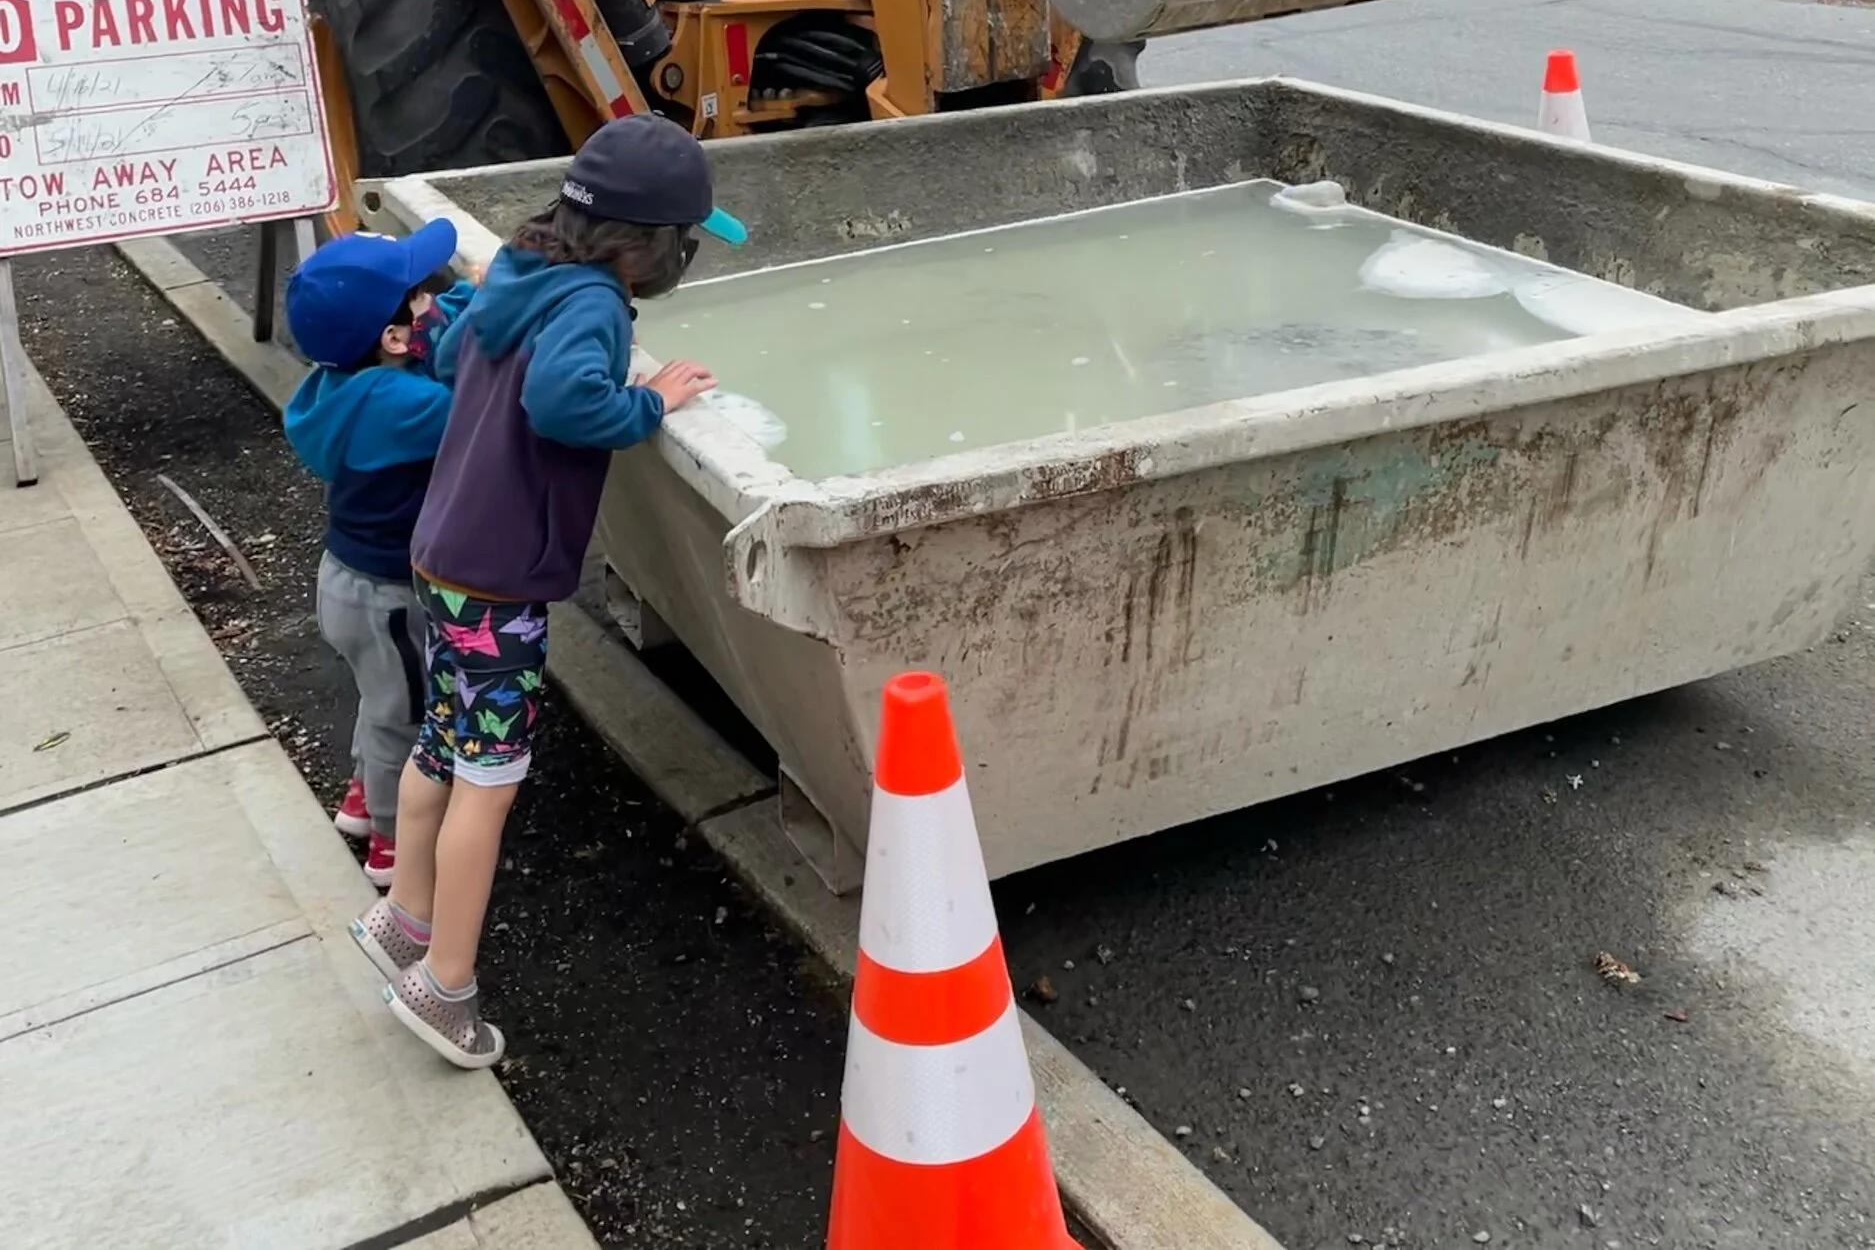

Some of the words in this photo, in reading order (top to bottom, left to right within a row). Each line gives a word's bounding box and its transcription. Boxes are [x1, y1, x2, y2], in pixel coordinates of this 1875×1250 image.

[0, 171, 64, 202] TOW
[93, 158, 177, 191] AWAY
[206, 146, 288, 177] AREA
[14, 215, 101, 239] NORTHWEST
[109, 205, 182, 227] CONCRETE
[190, 199, 226, 216] (206)
[229, 191, 290, 210] 386-1218
[39, 193, 120, 217] PHONE
